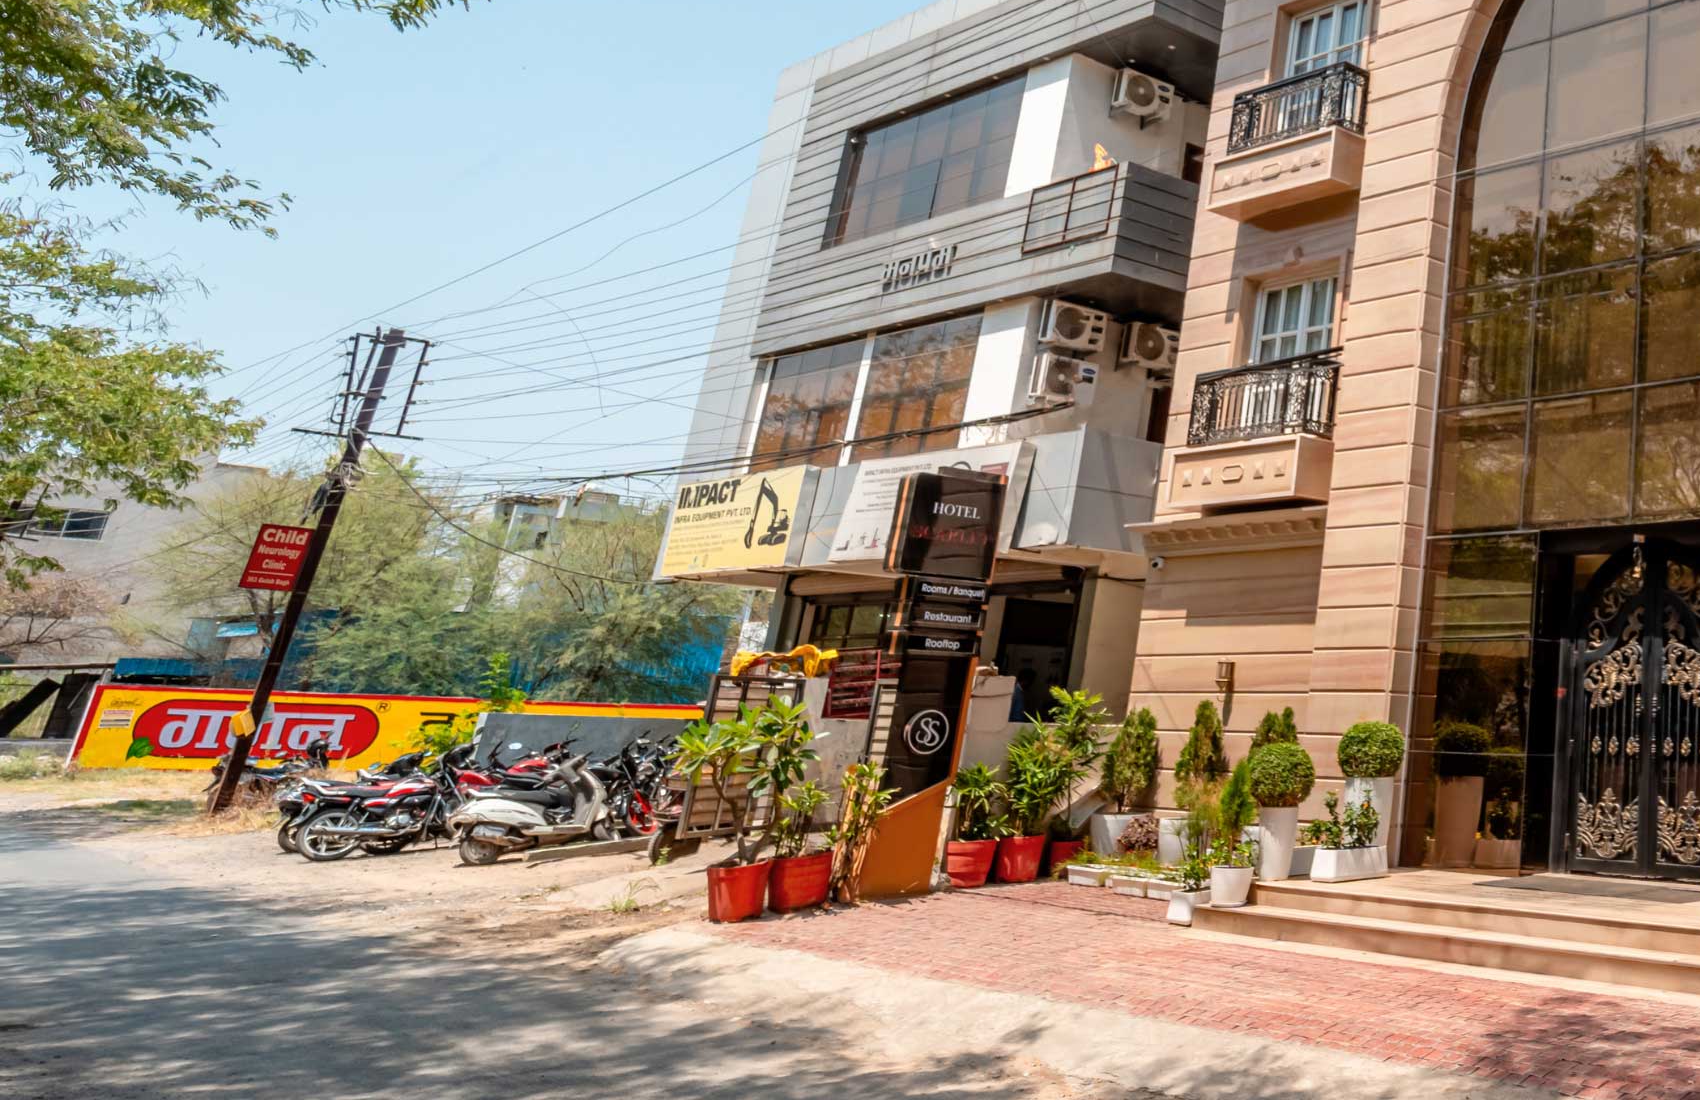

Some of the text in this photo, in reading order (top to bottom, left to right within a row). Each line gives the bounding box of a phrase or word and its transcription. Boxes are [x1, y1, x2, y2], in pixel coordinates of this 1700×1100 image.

[678, 479, 741, 509] IMPACT
[674, 516, 690, 524] INFRA
[692, 510, 725, 522] EQUIPMENT
[932, 502, 981, 519] HOTEL
[263, 528, 309, 545] Child
[257, 544, 301, 560] Neurology
[262, 558, 287, 570] Clinic
[921, 583, 947, 595] Rooms
[953, 587, 985, 598] Banquet
[924, 611, 972, 623] Restaurant
[925, 638, 960, 650] Rooftop
